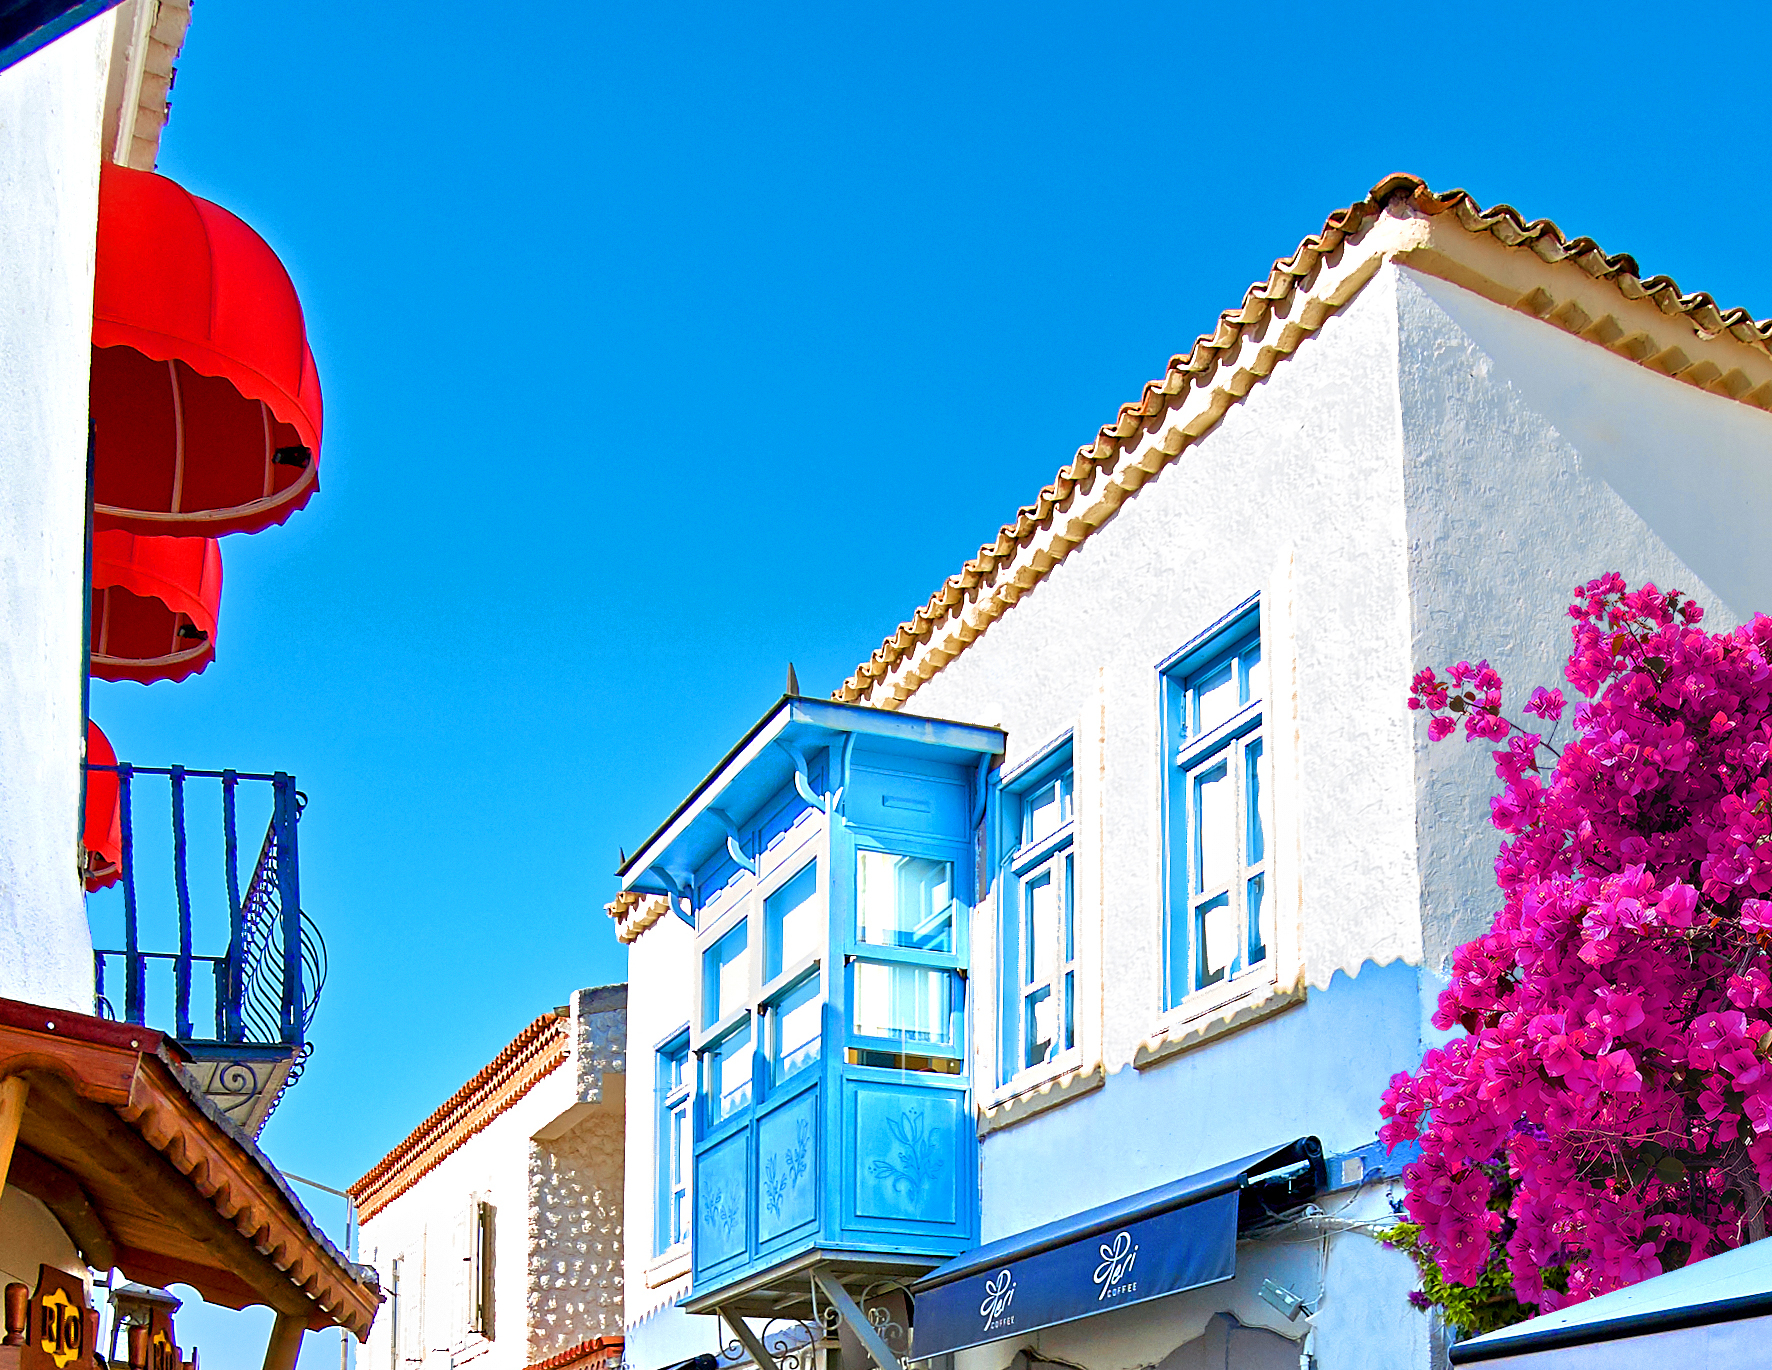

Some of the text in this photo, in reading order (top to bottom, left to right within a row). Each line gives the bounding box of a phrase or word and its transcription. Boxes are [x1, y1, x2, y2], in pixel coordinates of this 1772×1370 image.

[1093, 1231, 1139, 1300] Peri
[1106, 1281, 1138, 1298] COFFEE
[980, 1269, 1017, 1332] Peri
[989, 1315, 1016, 1330] COFFEE
[41, 1302, 82, 1356] RIO
